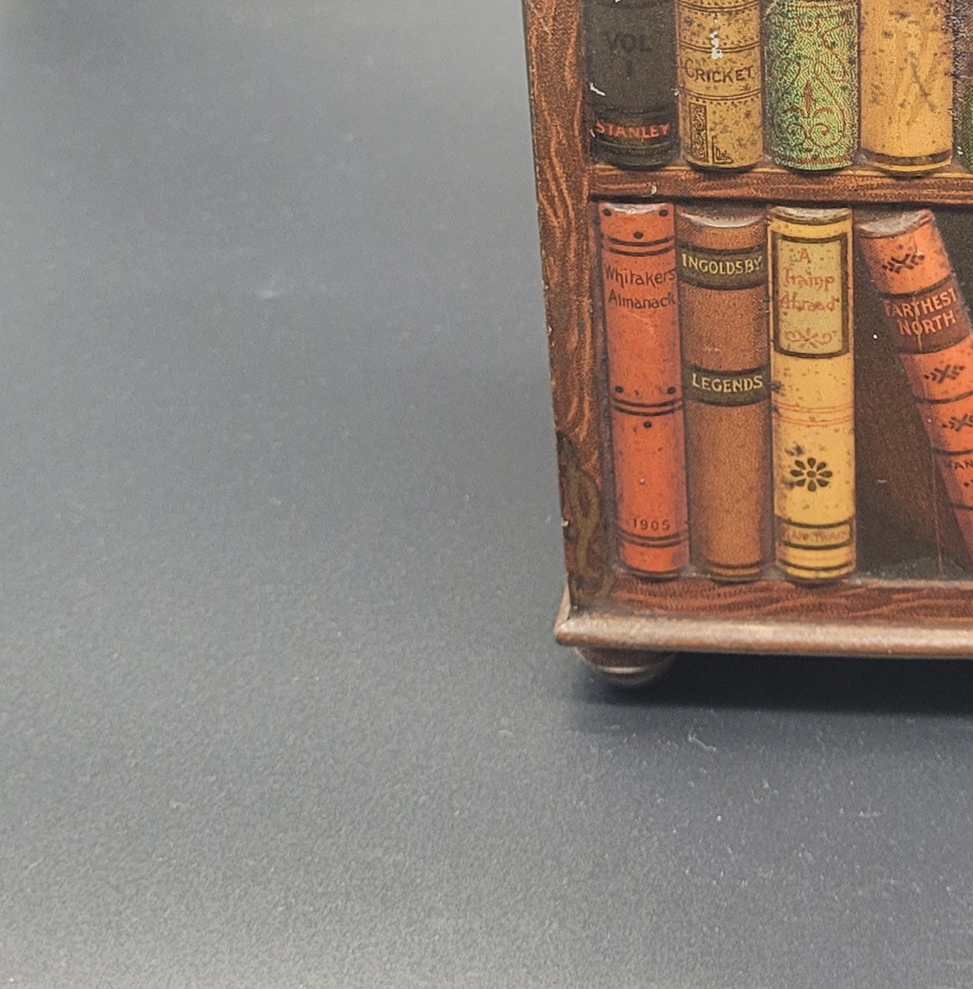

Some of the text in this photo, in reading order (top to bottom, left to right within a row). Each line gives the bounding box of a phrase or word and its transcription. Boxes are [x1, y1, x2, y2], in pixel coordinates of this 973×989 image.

[684, 57, 755, 84] CRICKET
[595, 120, 670, 140] STANLEY
[681, 253, 763, 275] INGOLDSBY
[800, 248, 811, 263] A
[782, 266, 836, 292] Tramp
[608, 289, 676, 309] Almanack
[882, 287, 957, 319] FARTHEST
[896, 310, 957, 337] NORTH
[691, 372, 764, 394] LEGENDS
[633, 517, 671, 532] 1905
